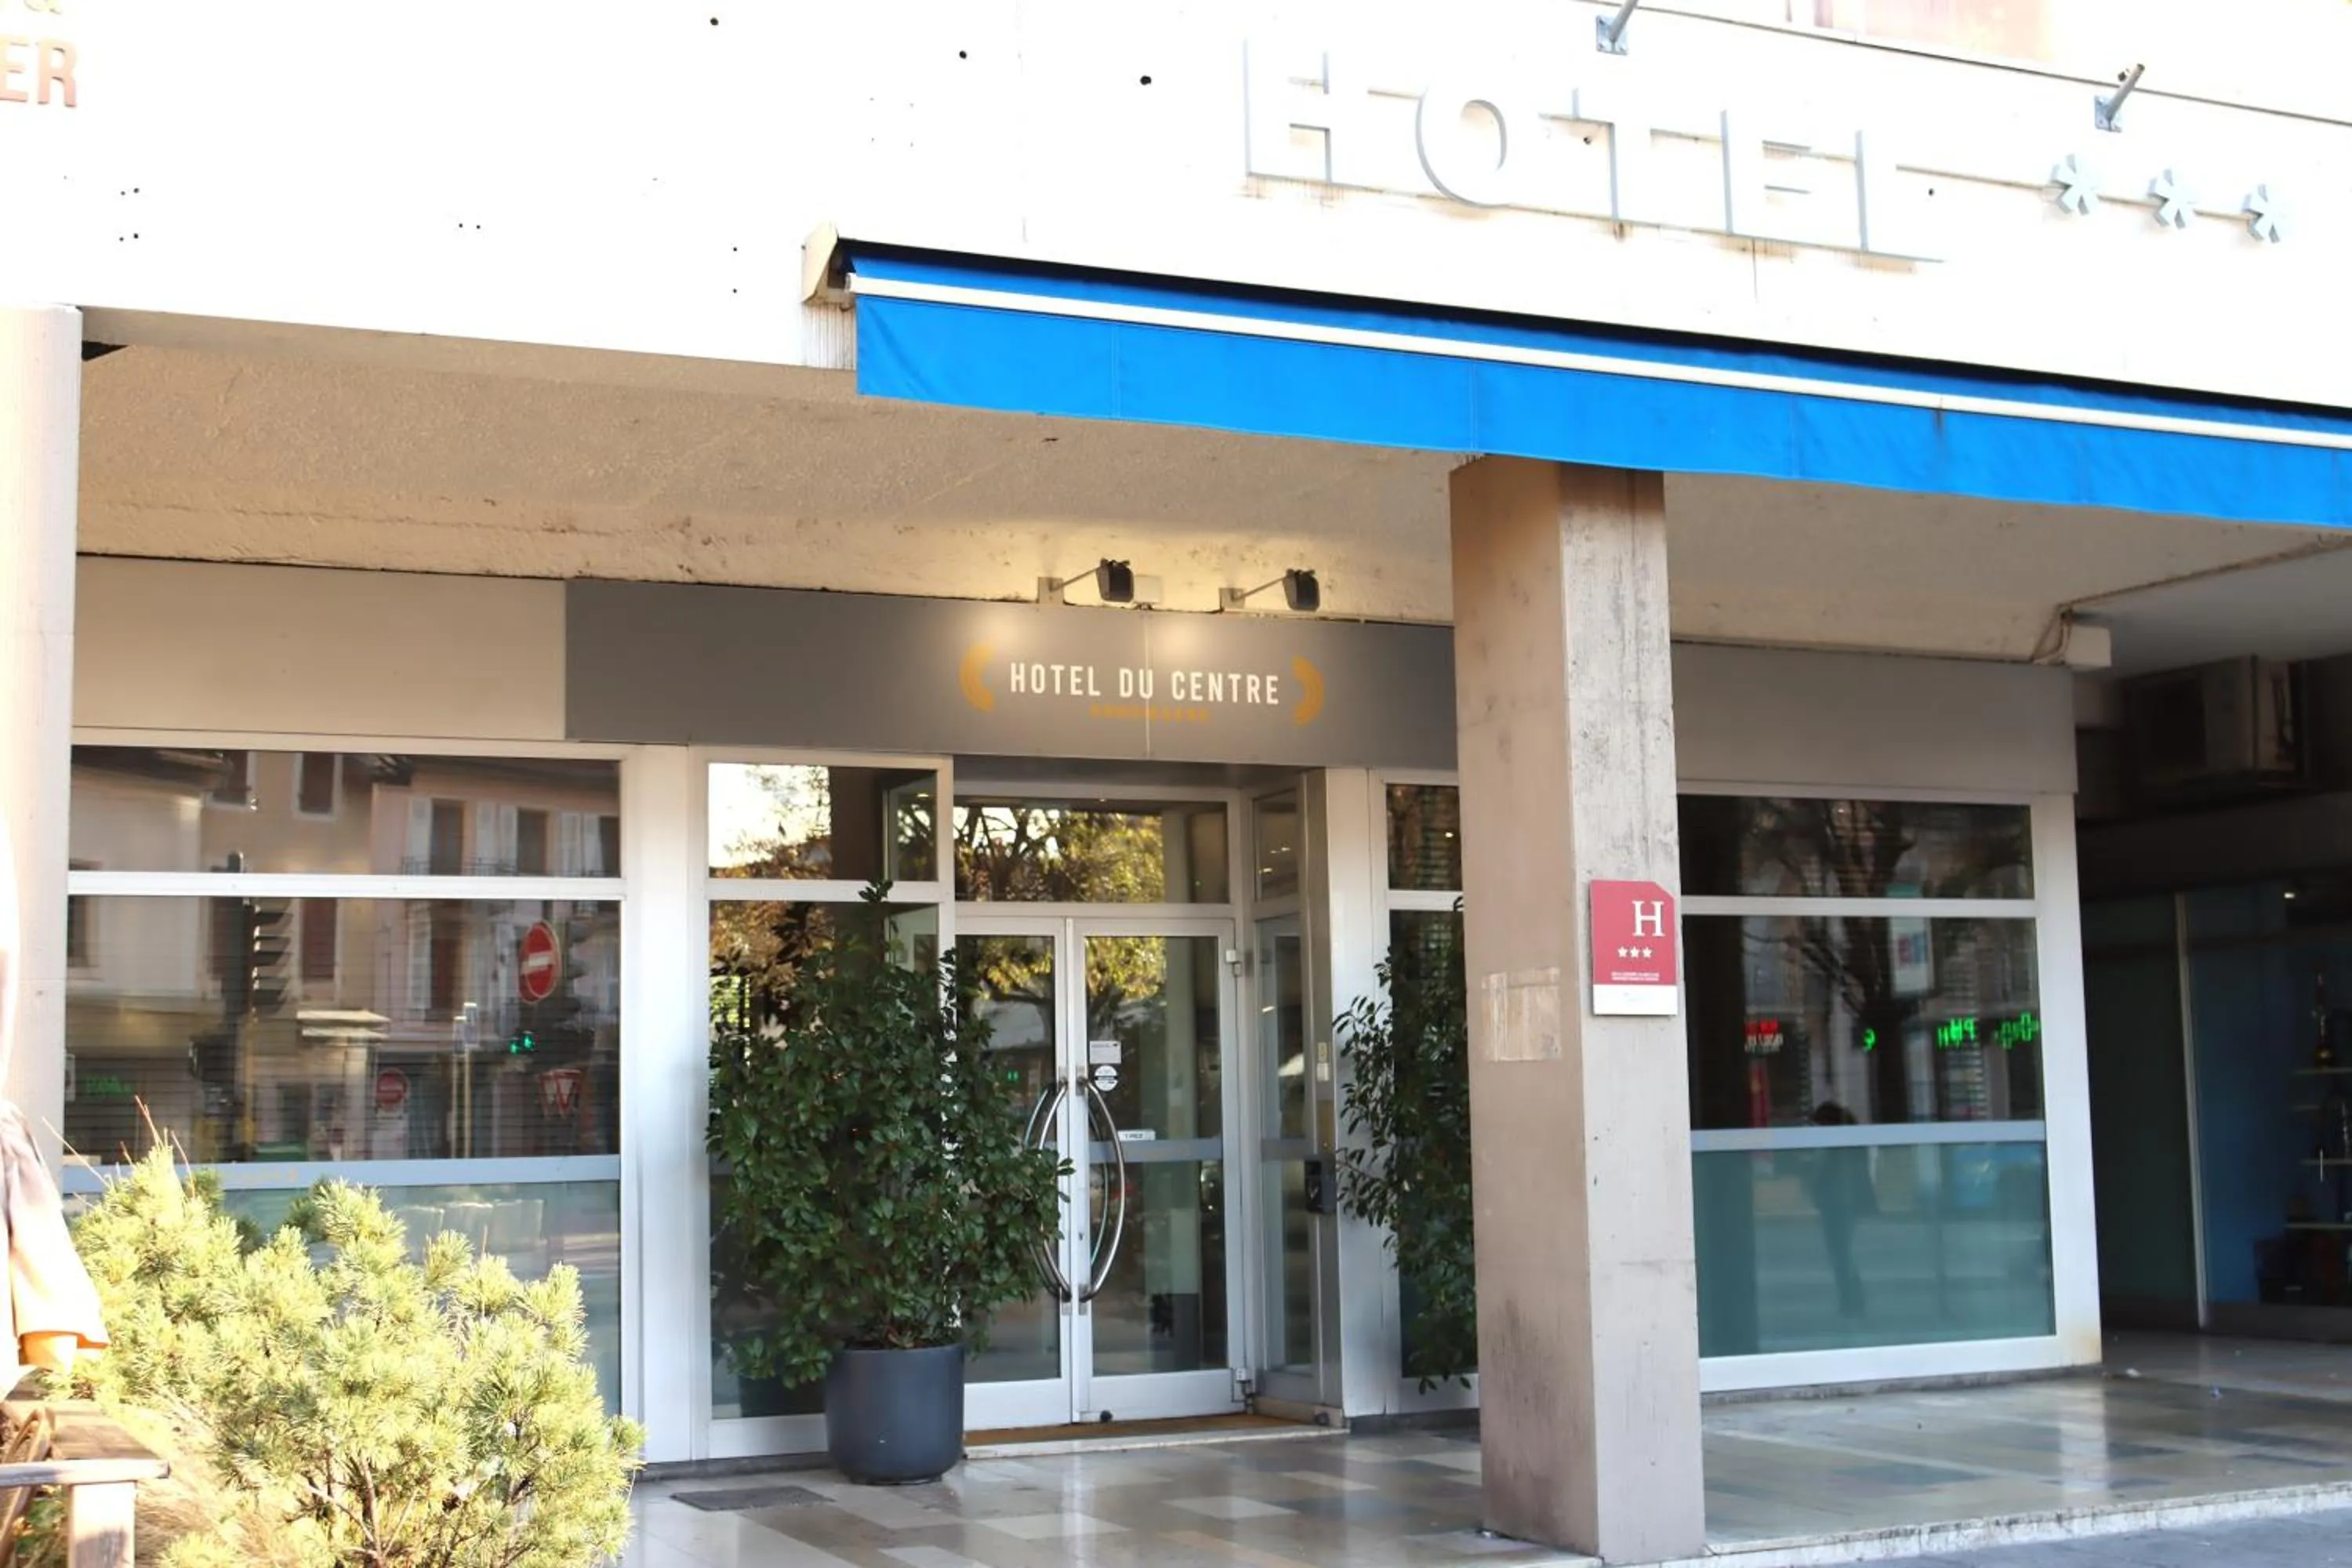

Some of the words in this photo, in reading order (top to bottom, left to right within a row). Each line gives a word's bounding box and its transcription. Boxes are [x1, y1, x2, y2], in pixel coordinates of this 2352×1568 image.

[1242, 36, 1945, 263] HOTEL
[1010, 662, 1102, 696] HOTEL
[1119, 667, 1154, 699] DU
[1171, 670, 1279, 705] CENTRE
[1632, 900, 1666, 937] H
